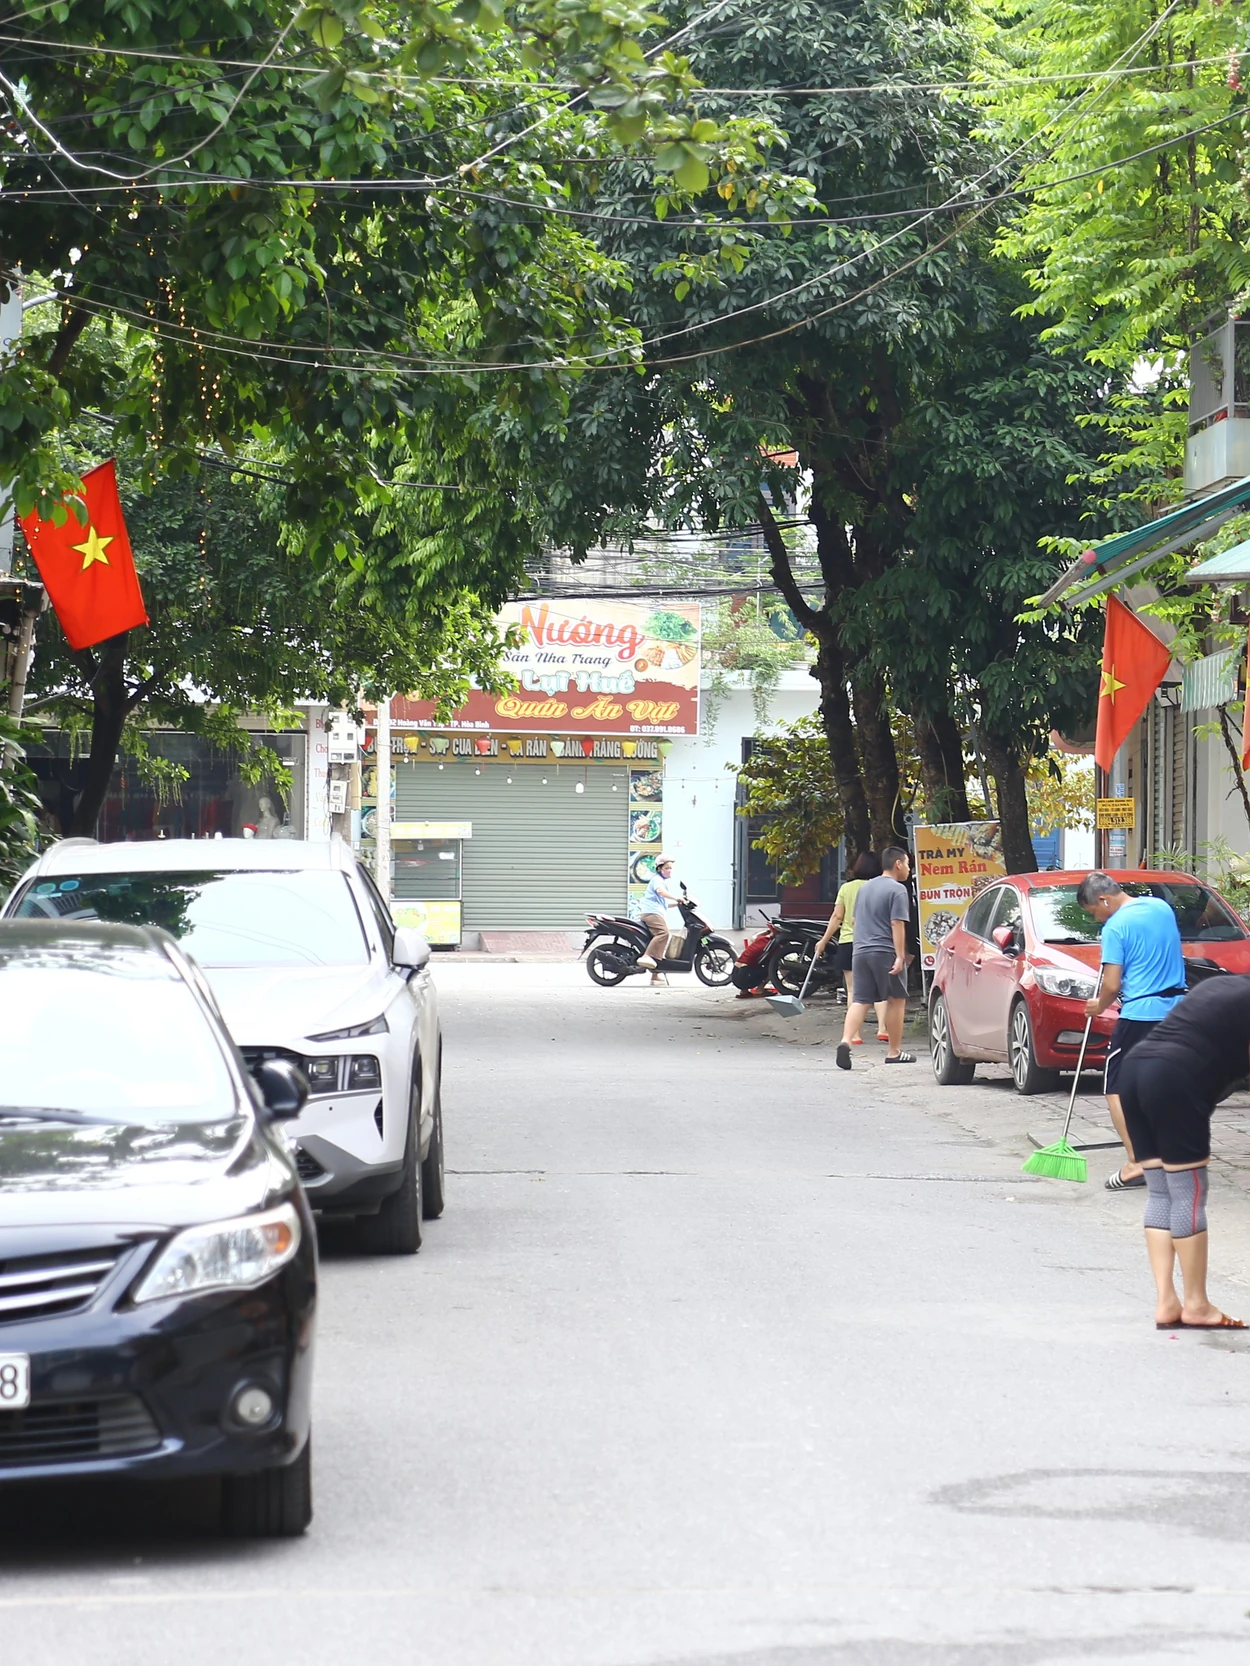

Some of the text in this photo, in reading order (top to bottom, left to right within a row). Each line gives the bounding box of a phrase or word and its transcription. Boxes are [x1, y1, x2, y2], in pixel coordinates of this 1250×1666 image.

[512, 602, 646, 661] Nướng
[535, 652, 567, 664] Nha
[571, 653, 612, 668] Trang
[575, 669, 635, 695] Huế
[495, 694, 680, 724] Quán Ăn Vặt
[452, 737, 472, 755] CUA
[526, 736, 547, 757] RÁN
[589, 738, 620, 760] RÁNG
[918, 847, 965, 860] TRÀ MY
[920, 859, 987, 876] Nem Rán
[920, 886, 971, 900] BÚN TRỘN
